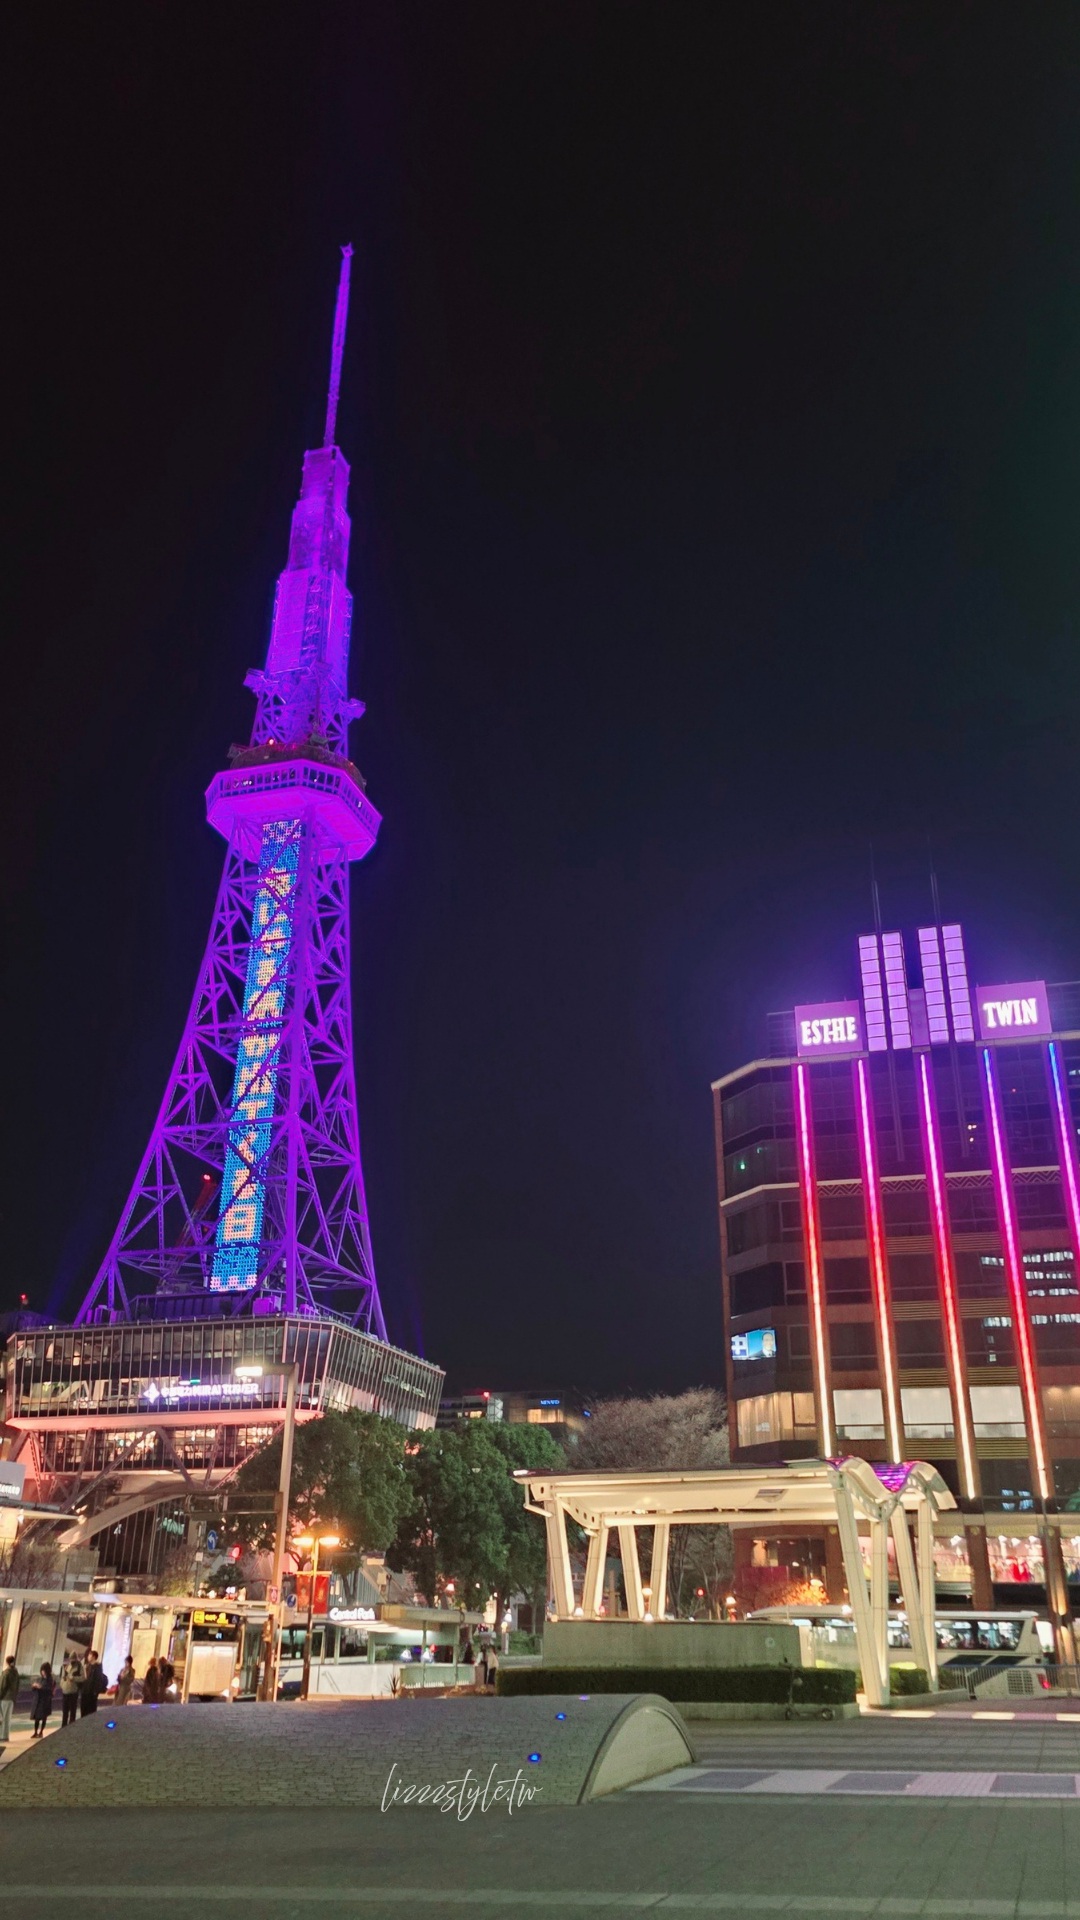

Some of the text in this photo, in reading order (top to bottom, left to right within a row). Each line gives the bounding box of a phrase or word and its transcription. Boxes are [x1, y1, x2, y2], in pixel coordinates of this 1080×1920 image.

[983, 998, 1038, 1028] TWIN
[801, 1017, 858, 1046] ESTHE
[193, 1383, 259, 1396] MIRAI TOWER
